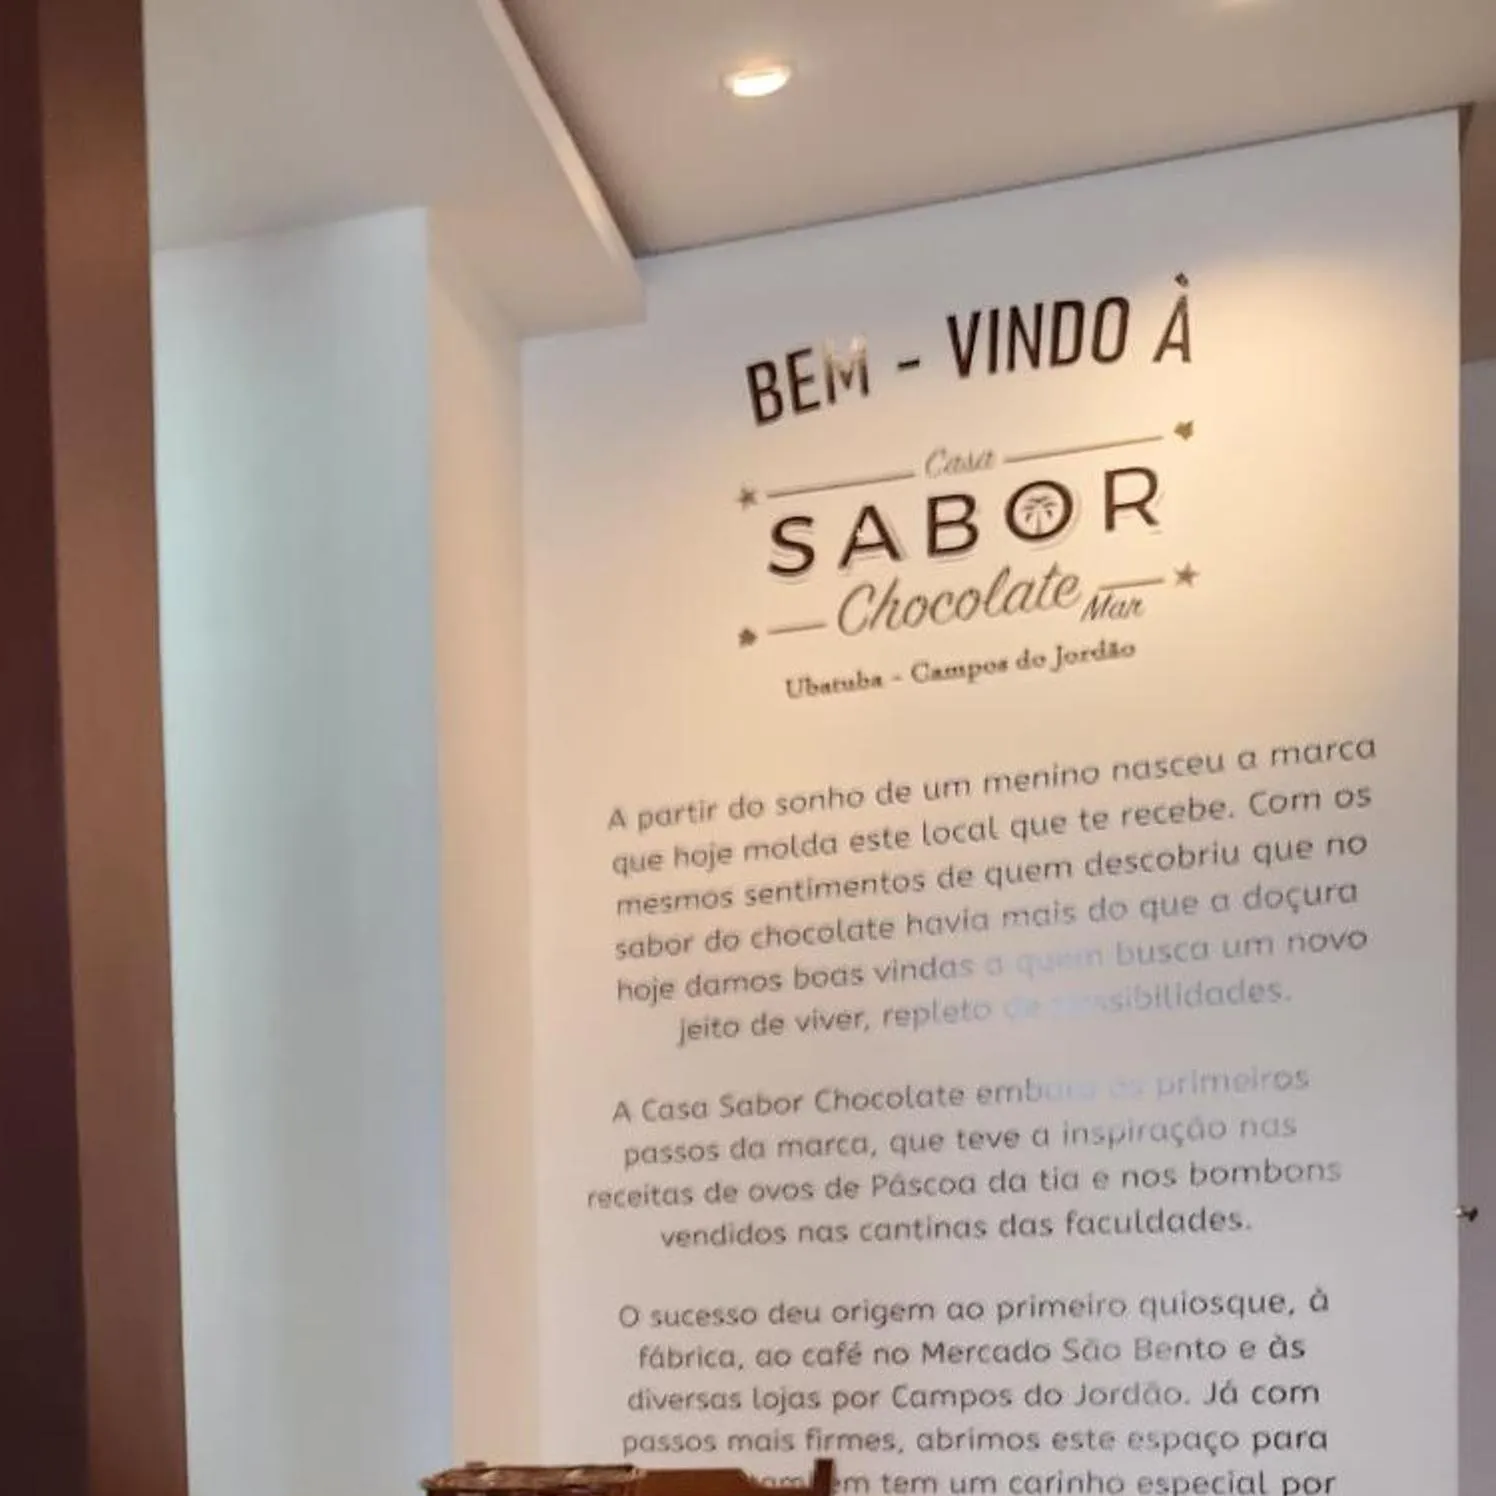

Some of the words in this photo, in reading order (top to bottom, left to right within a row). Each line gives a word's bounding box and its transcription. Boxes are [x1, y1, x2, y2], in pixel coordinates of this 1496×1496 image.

[746, 333, 869, 427] BEM
[947, 297, 1130, 379] VINDO
[1152, 272, 1193, 365] À
[924, 447, 997, 479] Casa
[767, 466, 1160, 577] SABOR
[838, 561, 1083, 635] Chocolate
[1080, 593, 1146, 622] Mar
[786, 671, 883, 698] Ubatuba
[911, 658, 1009, 684] Campos
[1016, 648, 1046, 671] do
[1049, 638, 1136, 673] Jordão
[607, 807, 628, 831] A
[637, 799, 718, 835] partir
[727, 794, 765, 821] do
[775, 784, 865, 816] sonho
[875, 780, 912, 806] de
[923, 778, 971, 801] um
[983, 763, 1101, 795] menino
[1112, 754, 1225, 783] nasceu
[1237, 751, 1257, 771] a
[1271, 740, 1376, 767] marca
[612, 852, 664, 878] que
[673, 841, 733, 873] hoje
[743, 831, 838, 861] molda
[849, 827, 911, 853] este
[922, 815, 999, 846] local
[1010, 815, 1067, 843] que
[1079, 808, 1109, 832] te
[1121, 796, 1234, 828] recebe.
[1248, 789, 1322, 817] Com
[1334, 788, 1372, 810] os
[616, 888, 734, 917] mesmos
[744, 871, 926, 907] sentimentos
[936, 864, 973, 890] de
[984, 860, 1073, 890] quem
[1084, 841, 1240, 877] descobriu
[1252, 840, 1314, 868] que
[1326, 836, 1368, 856] no
[615, 933, 694, 961] sabor
[704, 928, 741, 953] do
[750, 917, 896, 950] chocolate
[906, 906, 990, 936] havia
[1002, 899, 1077, 928] mais
[1088, 896, 1129, 923] do
[1139, 895, 1199, 923] que
[1210, 893, 1231, 913] a
[1242, 883, 1358, 915] doçura
[617, 976, 676, 1007] hoje
[684, 972, 783, 998] damos
[793, 964, 865, 990] boas
[873, 956, 974, 984] vindas
[1116, 939, 1209, 967] busca
[1222, 937, 1274, 959] um
[1287, 931, 1368, 953] novo
[677, 1016, 740, 1049] jeito
[751, 1011, 785, 1037] de
[794, 1007, 871, 1033] viver,
[882, 997, 994, 1033] repleto
[612, 1099, 632, 1124] A
[641, 1097, 708, 1123] Casa
[718, 1092, 804, 1118] Sabor
[815, 1085, 965, 1115] Chocolate
[1157, 1066, 1311, 1101] primeiros
[624, 1142, 720, 1172] passos
[729, 1136, 766, 1161] da
[777, 1135, 877, 1159] marca,
[889, 1133, 945, 1159] que
[956, 1129, 1021, 1151] teve
[1031, 1128, 1050, 1147] a
[1063, 1116, 1228, 1152] inspiração
[1239, 1117, 1298, 1139] nas
[587, 1183, 694, 1209] receitas
[703, 1181, 739, 1205] de
[748, 1181, 815, 1203] ovos
[824, 1175, 861, 1200] de
[871, 1172, 977, 1197] Páscoa
[988, 1169, 1027, 1194] da
[1039, 1166, 1079, 1192] tia
[1092, 1169, 1110, 1190] e
[1121, 1168, 1178, 1188] nos
[1189, 1158, 1342, 1188] bombons
[660, 1222, 787, 1248] vendidos
[798, 1224, 849, 1244] nas
[859, 1214, 988, 1243] cantinas
[998, 1212, 1054, 1238] das
[1066, 1206, 1251, 1236] faculdades.
[618, 1304, 640, 1328] O
[651, 1306, 758, 1328] sucesso
[767, 1301, 821, 1325] deu
[831, 1299, 935, 1330] origem
[946, 1301, 985, 1322] ao
[996, 1292, 1128, 1326] primeiro
[1139, 1291, 1295, 1322] quiosque,
[1309, 1287, 1329, 1312] à
[639, 1344, 744, 1372] fábrica,
[754, 1348, 793, 1369] ao
[801, 1341, 863, 1368] café
[873, 1346, 911, 1367] no
[921, 1339, 1052, 1365] Mercado
[1062, 1337, 1122, 1364] São
[1134, 1337, 1227, 1361] Bento
[1239, 1340, 1256, 1360] e
[1268, 1333, 1306, 1359] às
[627, 1387, 743, 1412] diversas
[752, 1386, 822, 1417] lojas
[832, 1389, 881, 1415] por
[891, 1383, 1013, 1414] Campos
[1024, 1383, 1063, 1407] do
[1074, 1380, 1190, 1407] Jordão.
[1203, 1380, 1239, 1405] Já
[1251, 1384, 1320, 1405] com
[622, 1433, 718, 1457] passos
[727, 1428, 796, 1452] mais
[804, 1427, 904, 1454] firmes,
[916, 1426, 1041, 1453] abrimos
[1051, 1428, 1116, 1451] este
[1127, 1431, 1240, 1458] espaço
[1252, 1430, 1328, 1456] para
[880, 1473, 939, 1495] tem
[949, 1475, 998, 1495] um
[1008, 1469, 1125, 1496] carinho
